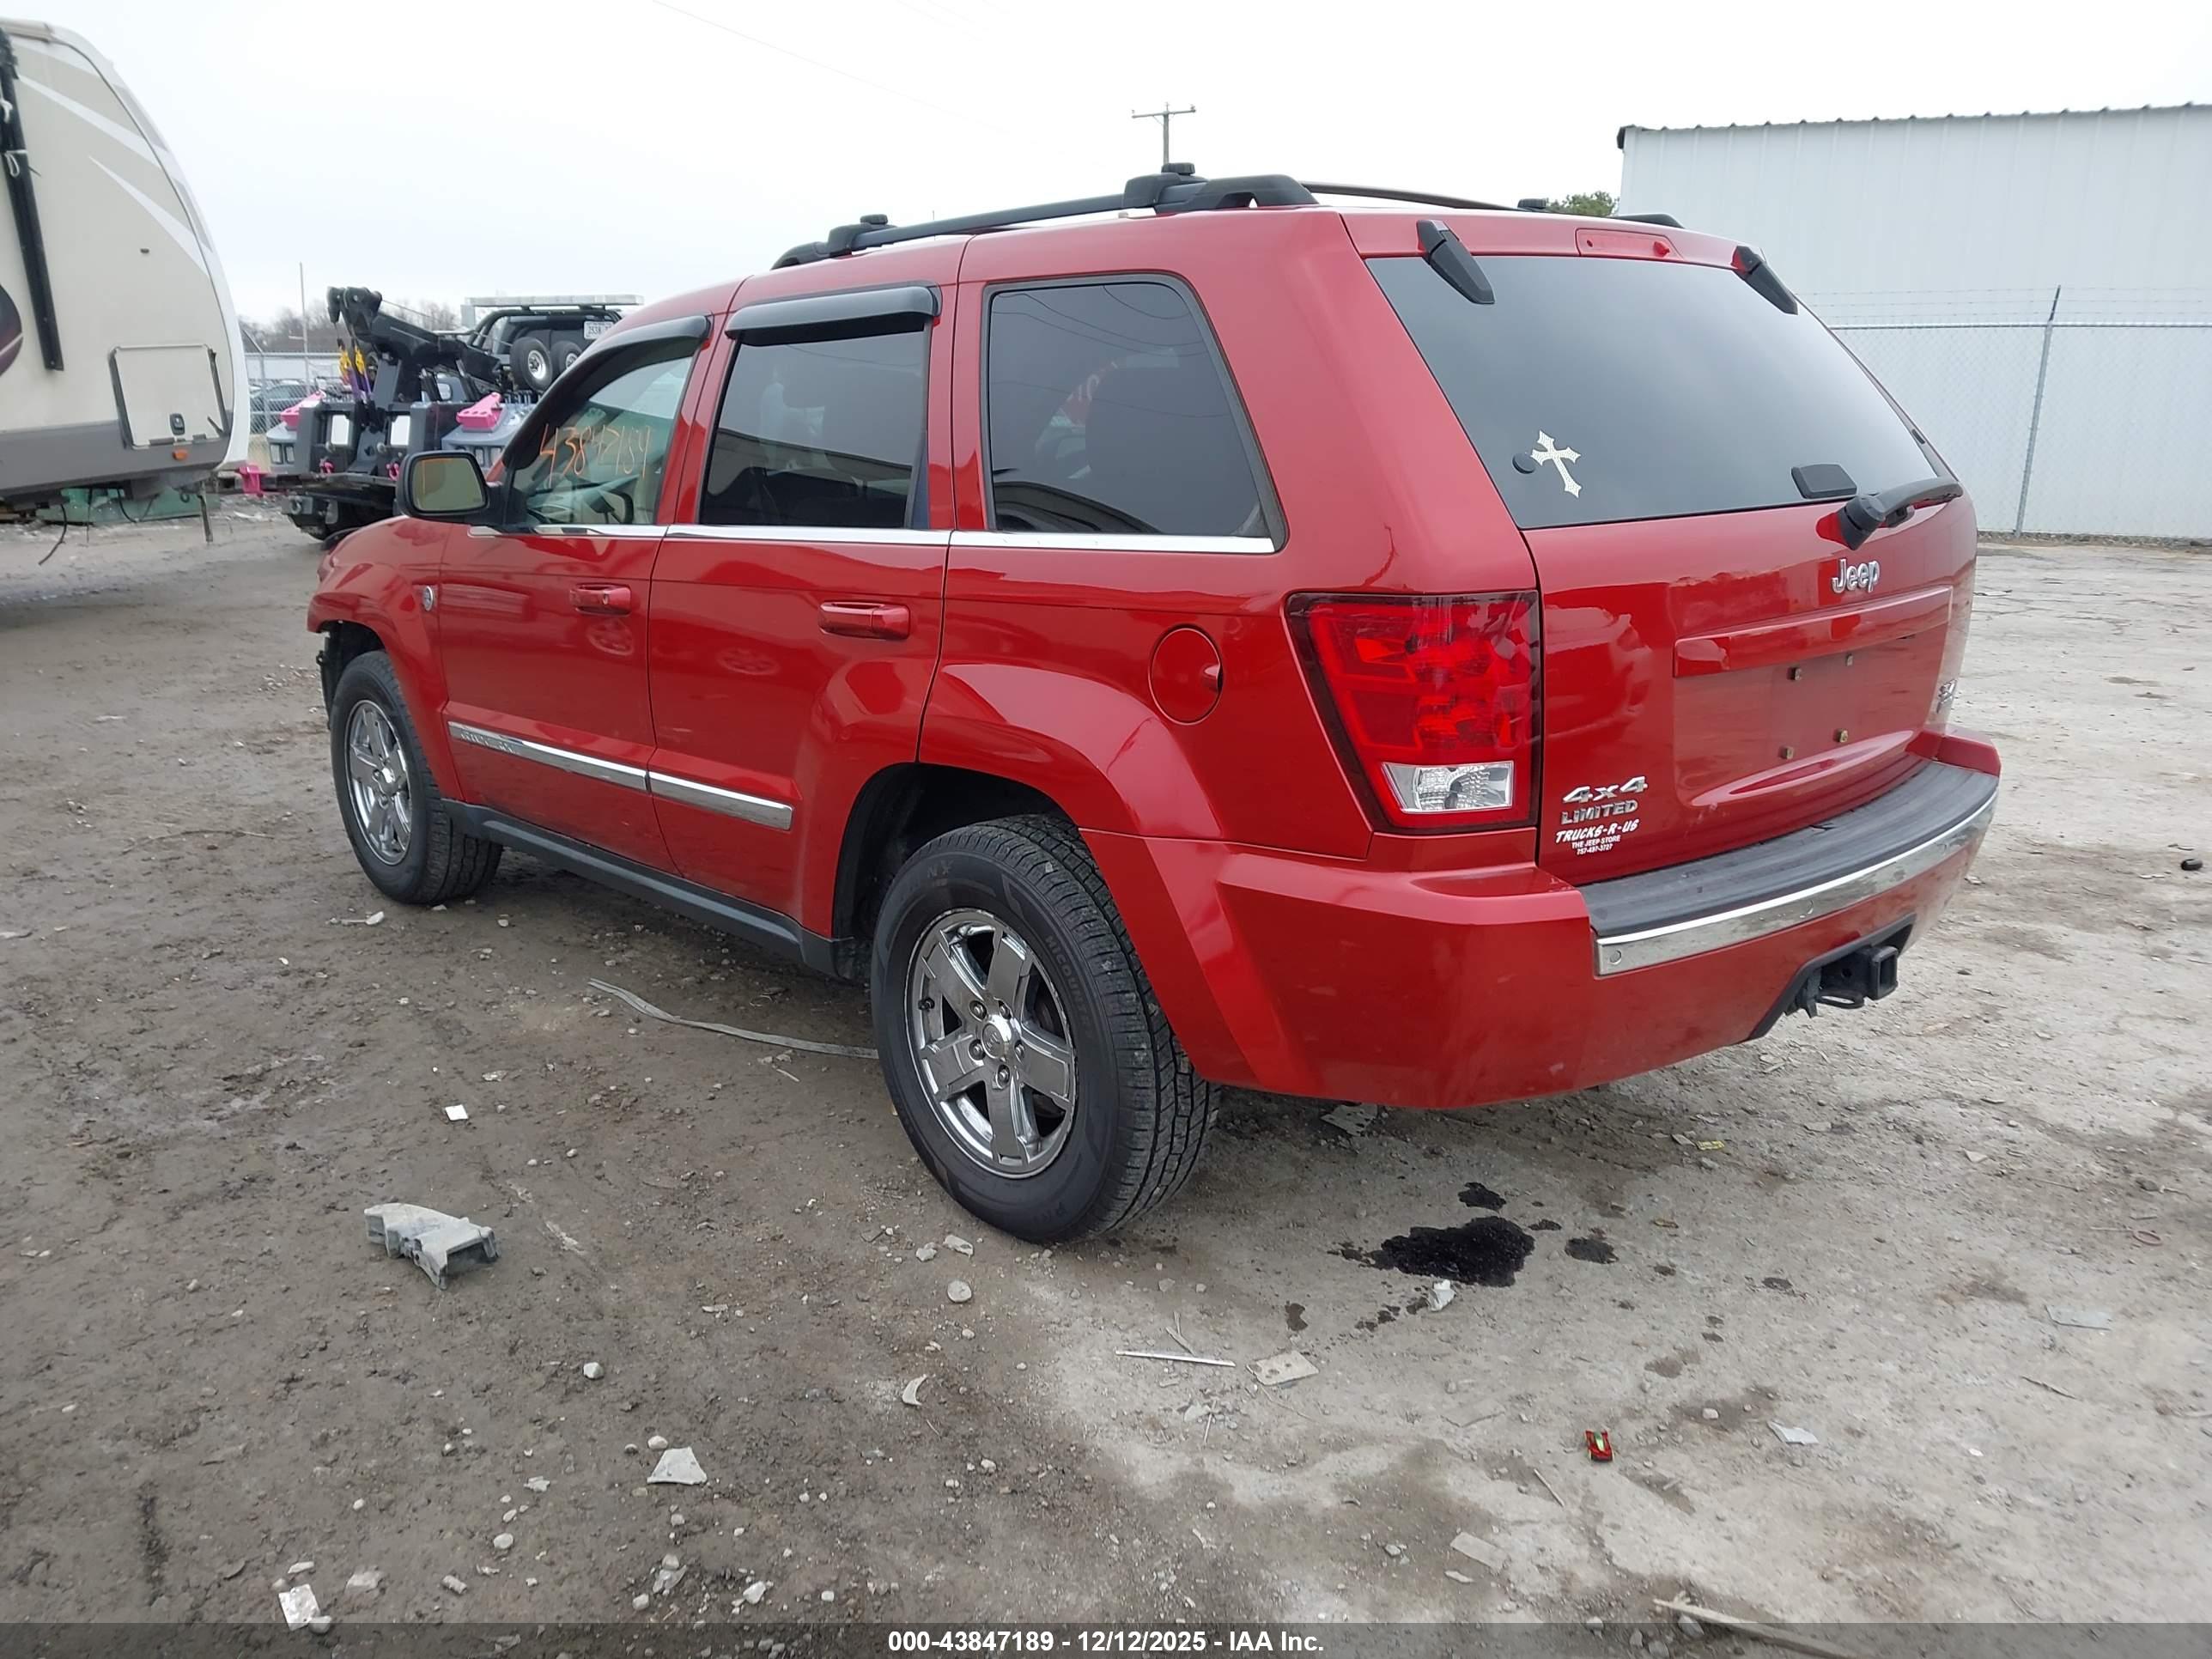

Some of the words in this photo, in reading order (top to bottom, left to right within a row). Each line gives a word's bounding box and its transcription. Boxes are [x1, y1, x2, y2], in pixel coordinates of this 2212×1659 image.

[1832, 558, 1881, 593] Jeep
[1562, 775, 1649, 804] 4x4
[1560, 799, 1638, 825] LIMITED
[1555, 818, 1640, 843] TRUCKS-R-US
[1571, 841, 1584, 849] THE
[1584, 838, 1601, 847] JEEP
[1601, 834, 1621, 844] STORE
